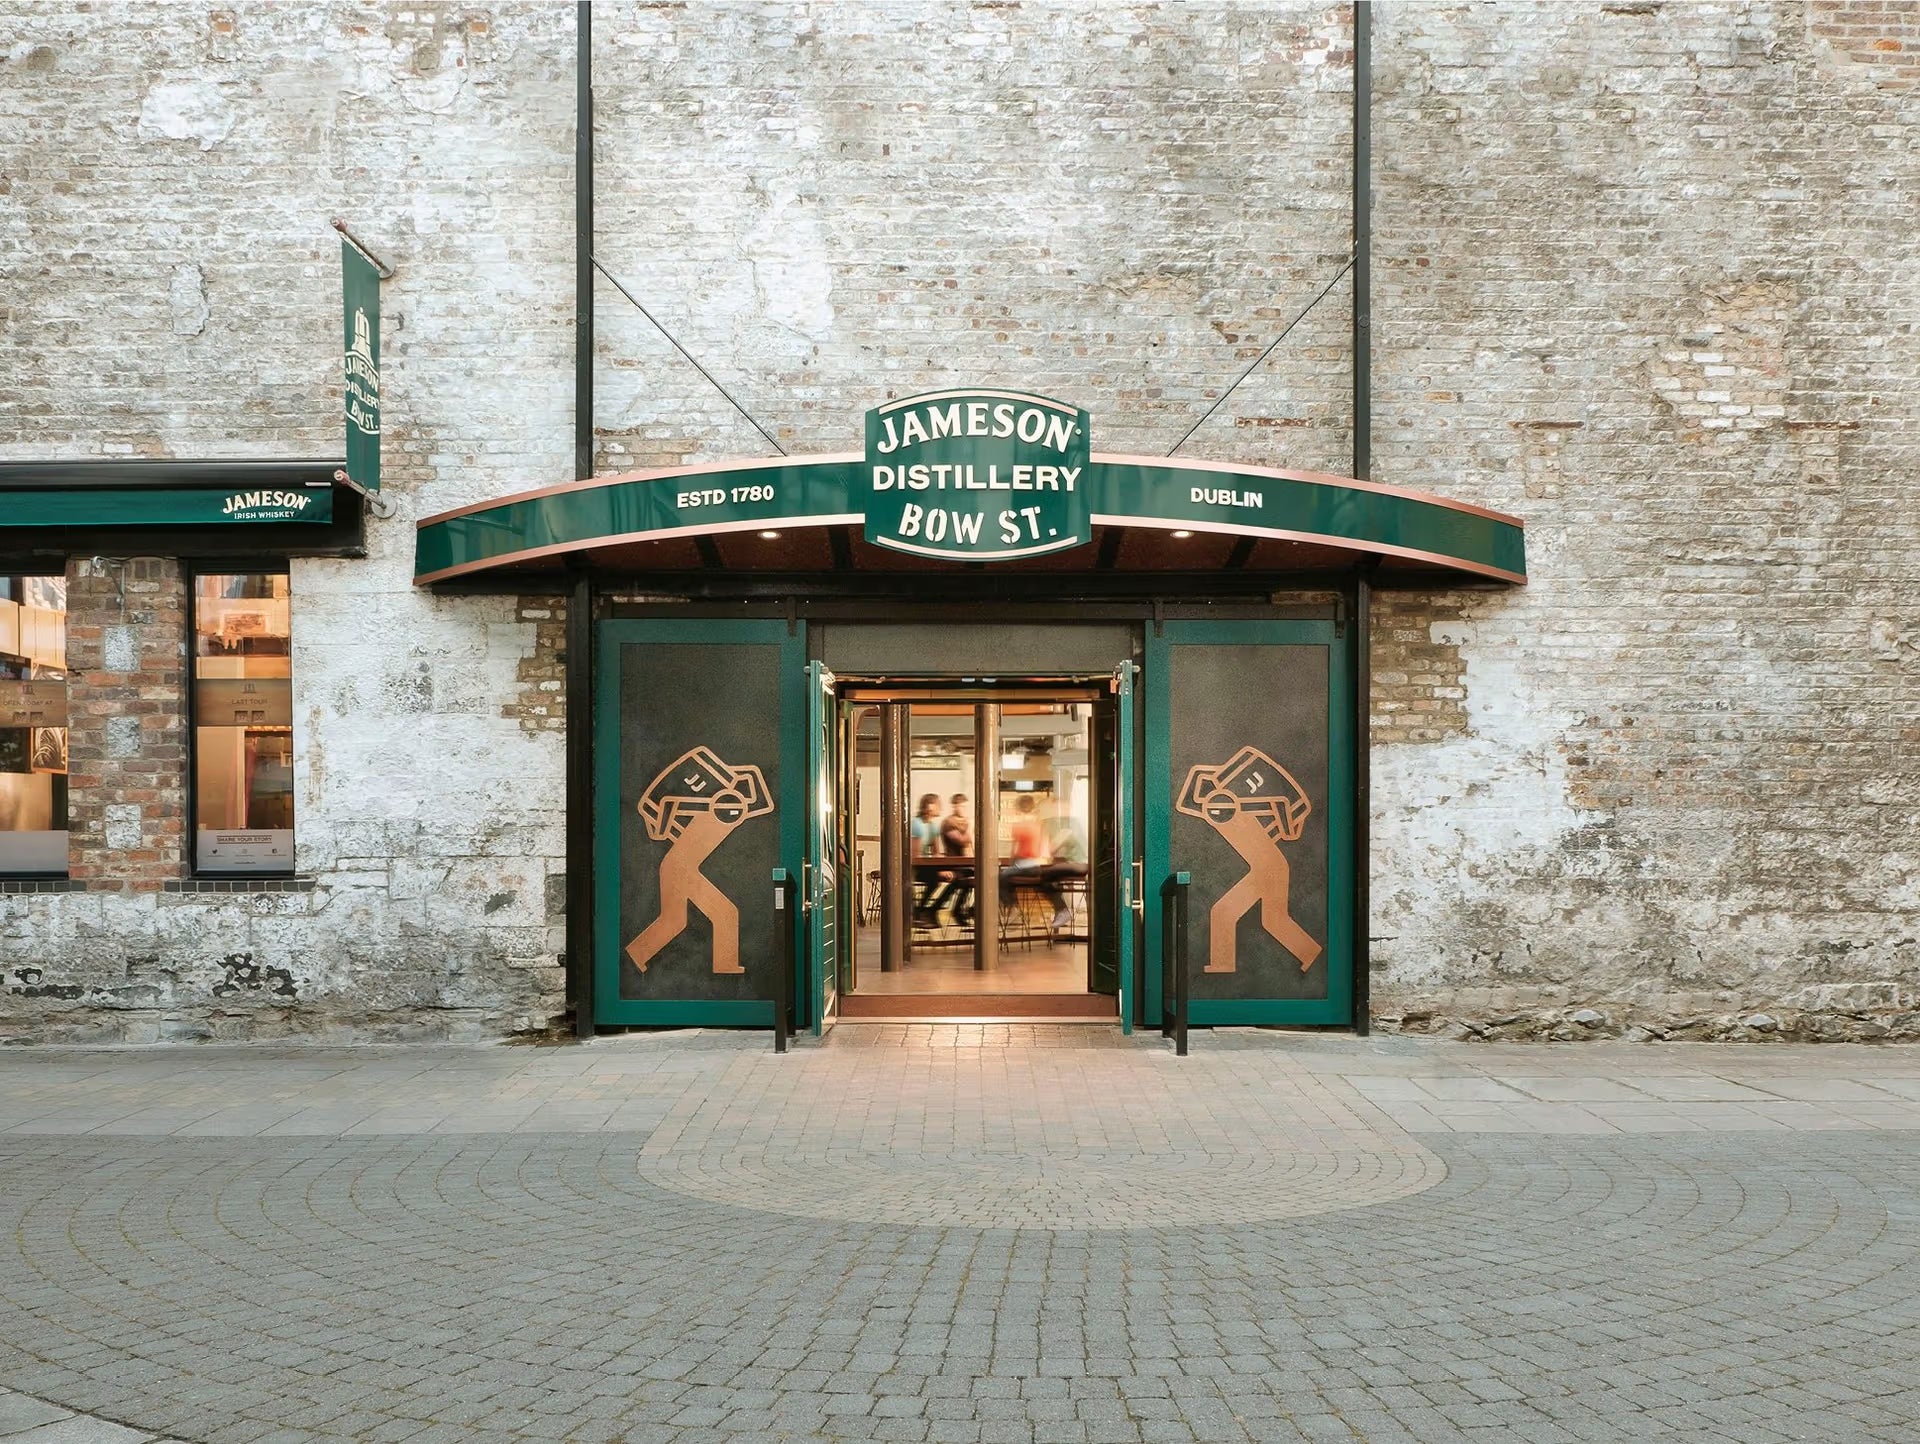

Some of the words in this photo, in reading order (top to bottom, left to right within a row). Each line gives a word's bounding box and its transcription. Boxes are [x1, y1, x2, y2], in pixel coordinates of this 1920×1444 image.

[877, 402, 1076, 453] JAMESON
[873, 464, 1082, 491] DISTILLERY
[223, 490, 309, 514] JAMESON
[677, 489, 726, 508] ESTD
[731, 485, 775, 503] 1780
[1191, 487, 1263, 508] DUBLIN
[898, 502, 984, 544] BOW
[998, 506, 1057, 544] ST.
